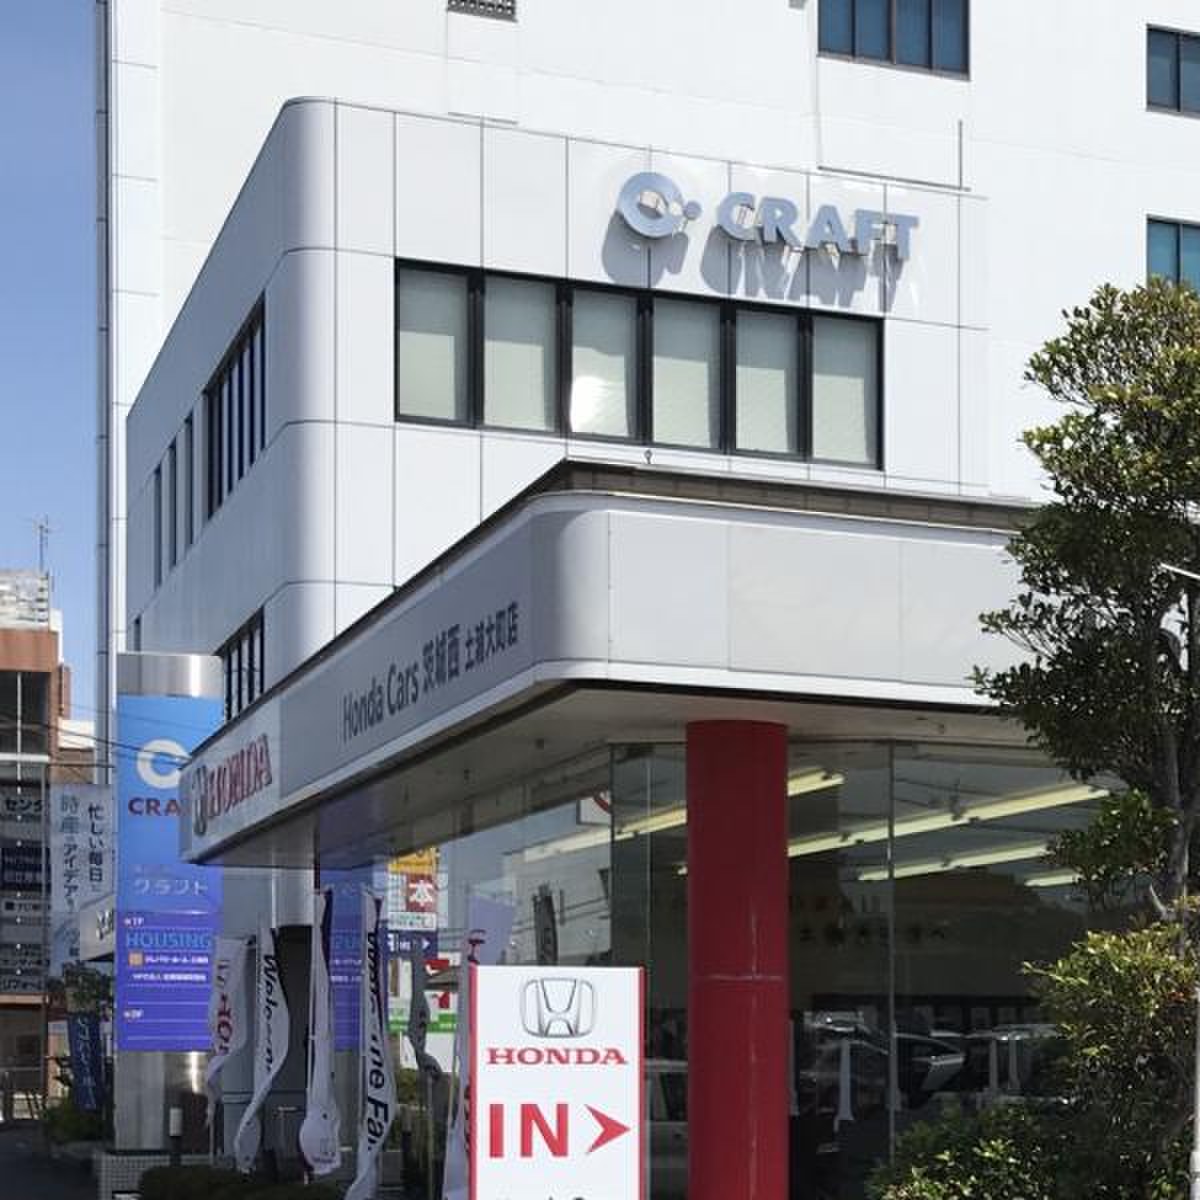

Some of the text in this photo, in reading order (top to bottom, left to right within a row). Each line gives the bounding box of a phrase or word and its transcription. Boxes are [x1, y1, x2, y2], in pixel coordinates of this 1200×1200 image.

[717, 192, 920, 261] CRAFT
[341, 679, 384, 743] Honda
[387, 661, 419, 717] Cars
[486, 1047, 628, 1065] HONDA
[488, 1103, 569, 1158] IN
